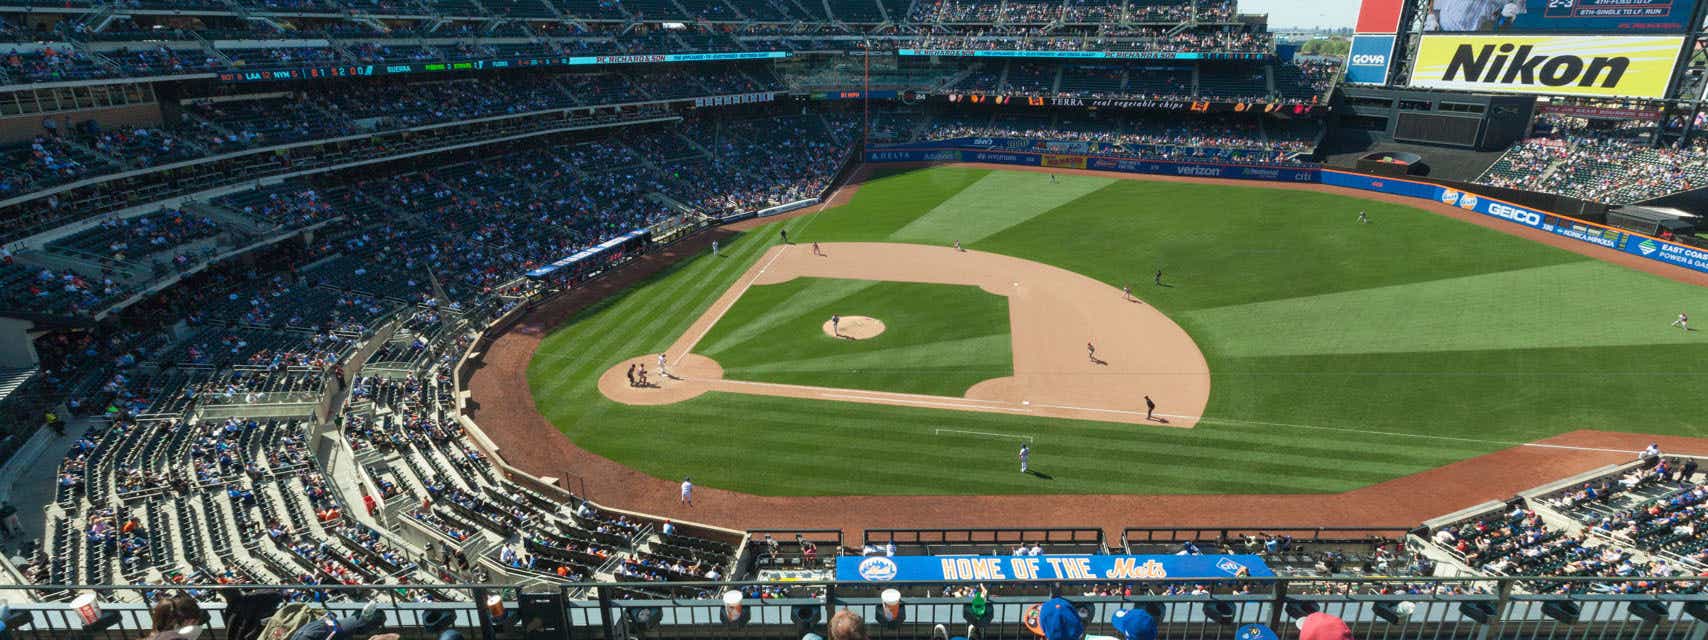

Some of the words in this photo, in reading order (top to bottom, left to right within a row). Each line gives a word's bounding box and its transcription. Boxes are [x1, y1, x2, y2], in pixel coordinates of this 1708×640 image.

[1352, 54, 1385, 64] GOYA
[1441, 43, 1631, 89] Nikon
[1052, 98, 1083, 106] TERRA
[1177, 165, 1220, 176] verizon
[1488, 202, 1540, 226] GEICO
[1662, 243, 1685, 253] EAST
[1659, 252, 1687, 263] POWER
[941, 558, 1006, 580] HOME
[1012, 558, 1040, 580] OF
[1047, 558, 1097, 579] THE
[1106, 558, 1167, 579] Mets
